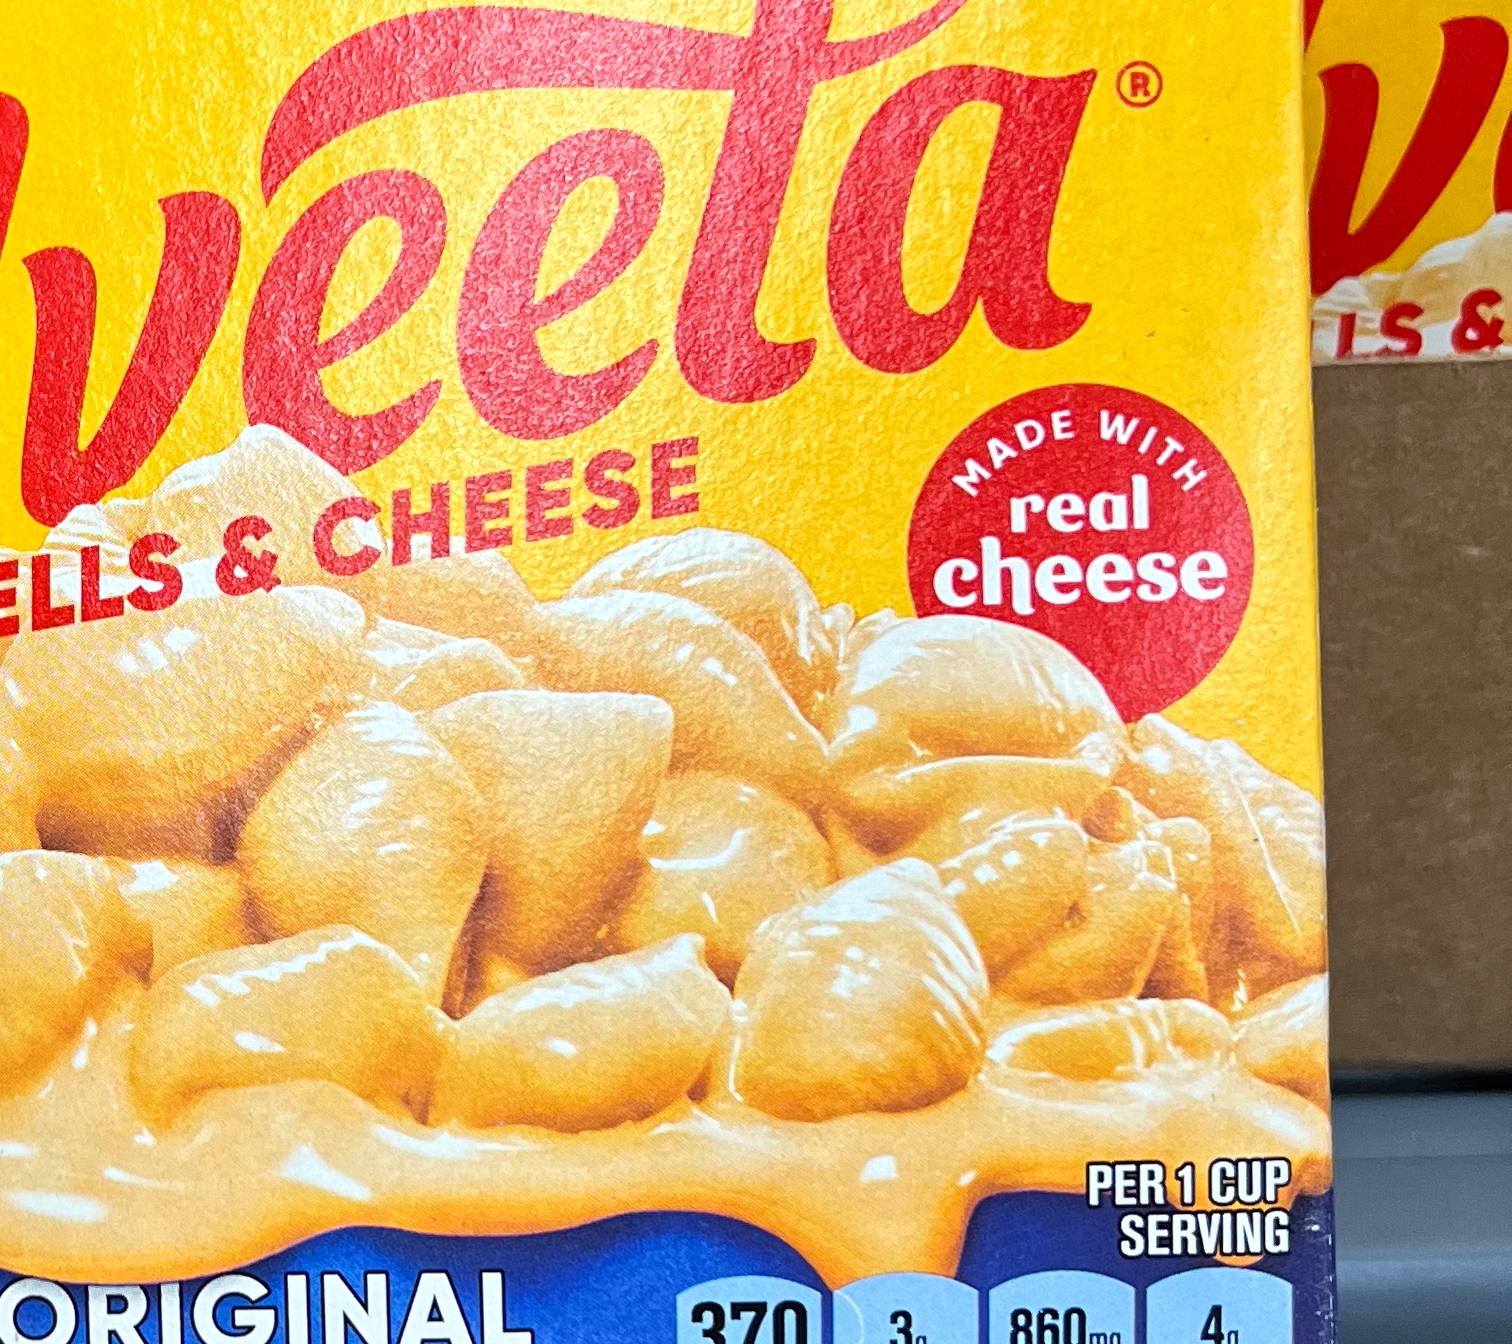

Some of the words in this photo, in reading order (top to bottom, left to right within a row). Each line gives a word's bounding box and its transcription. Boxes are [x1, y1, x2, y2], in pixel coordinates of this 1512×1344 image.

[951, 409, 1076, 498] MADE
[1099, 408, 1208, 492] WITH
[214, 514, 283, 598] &
[313, 435, 701, 578] CHEESE
[1009, 473, 1150, 534] real
[932, 535, 1229, 617] cheese
[1088, 1162, 1166, 1206] PER
[1175, 1162, 1196, 1204] 1
[1210, 1160, 1290, 1204] CUP
[1119, 1211, 1290, 1257] SERVING
